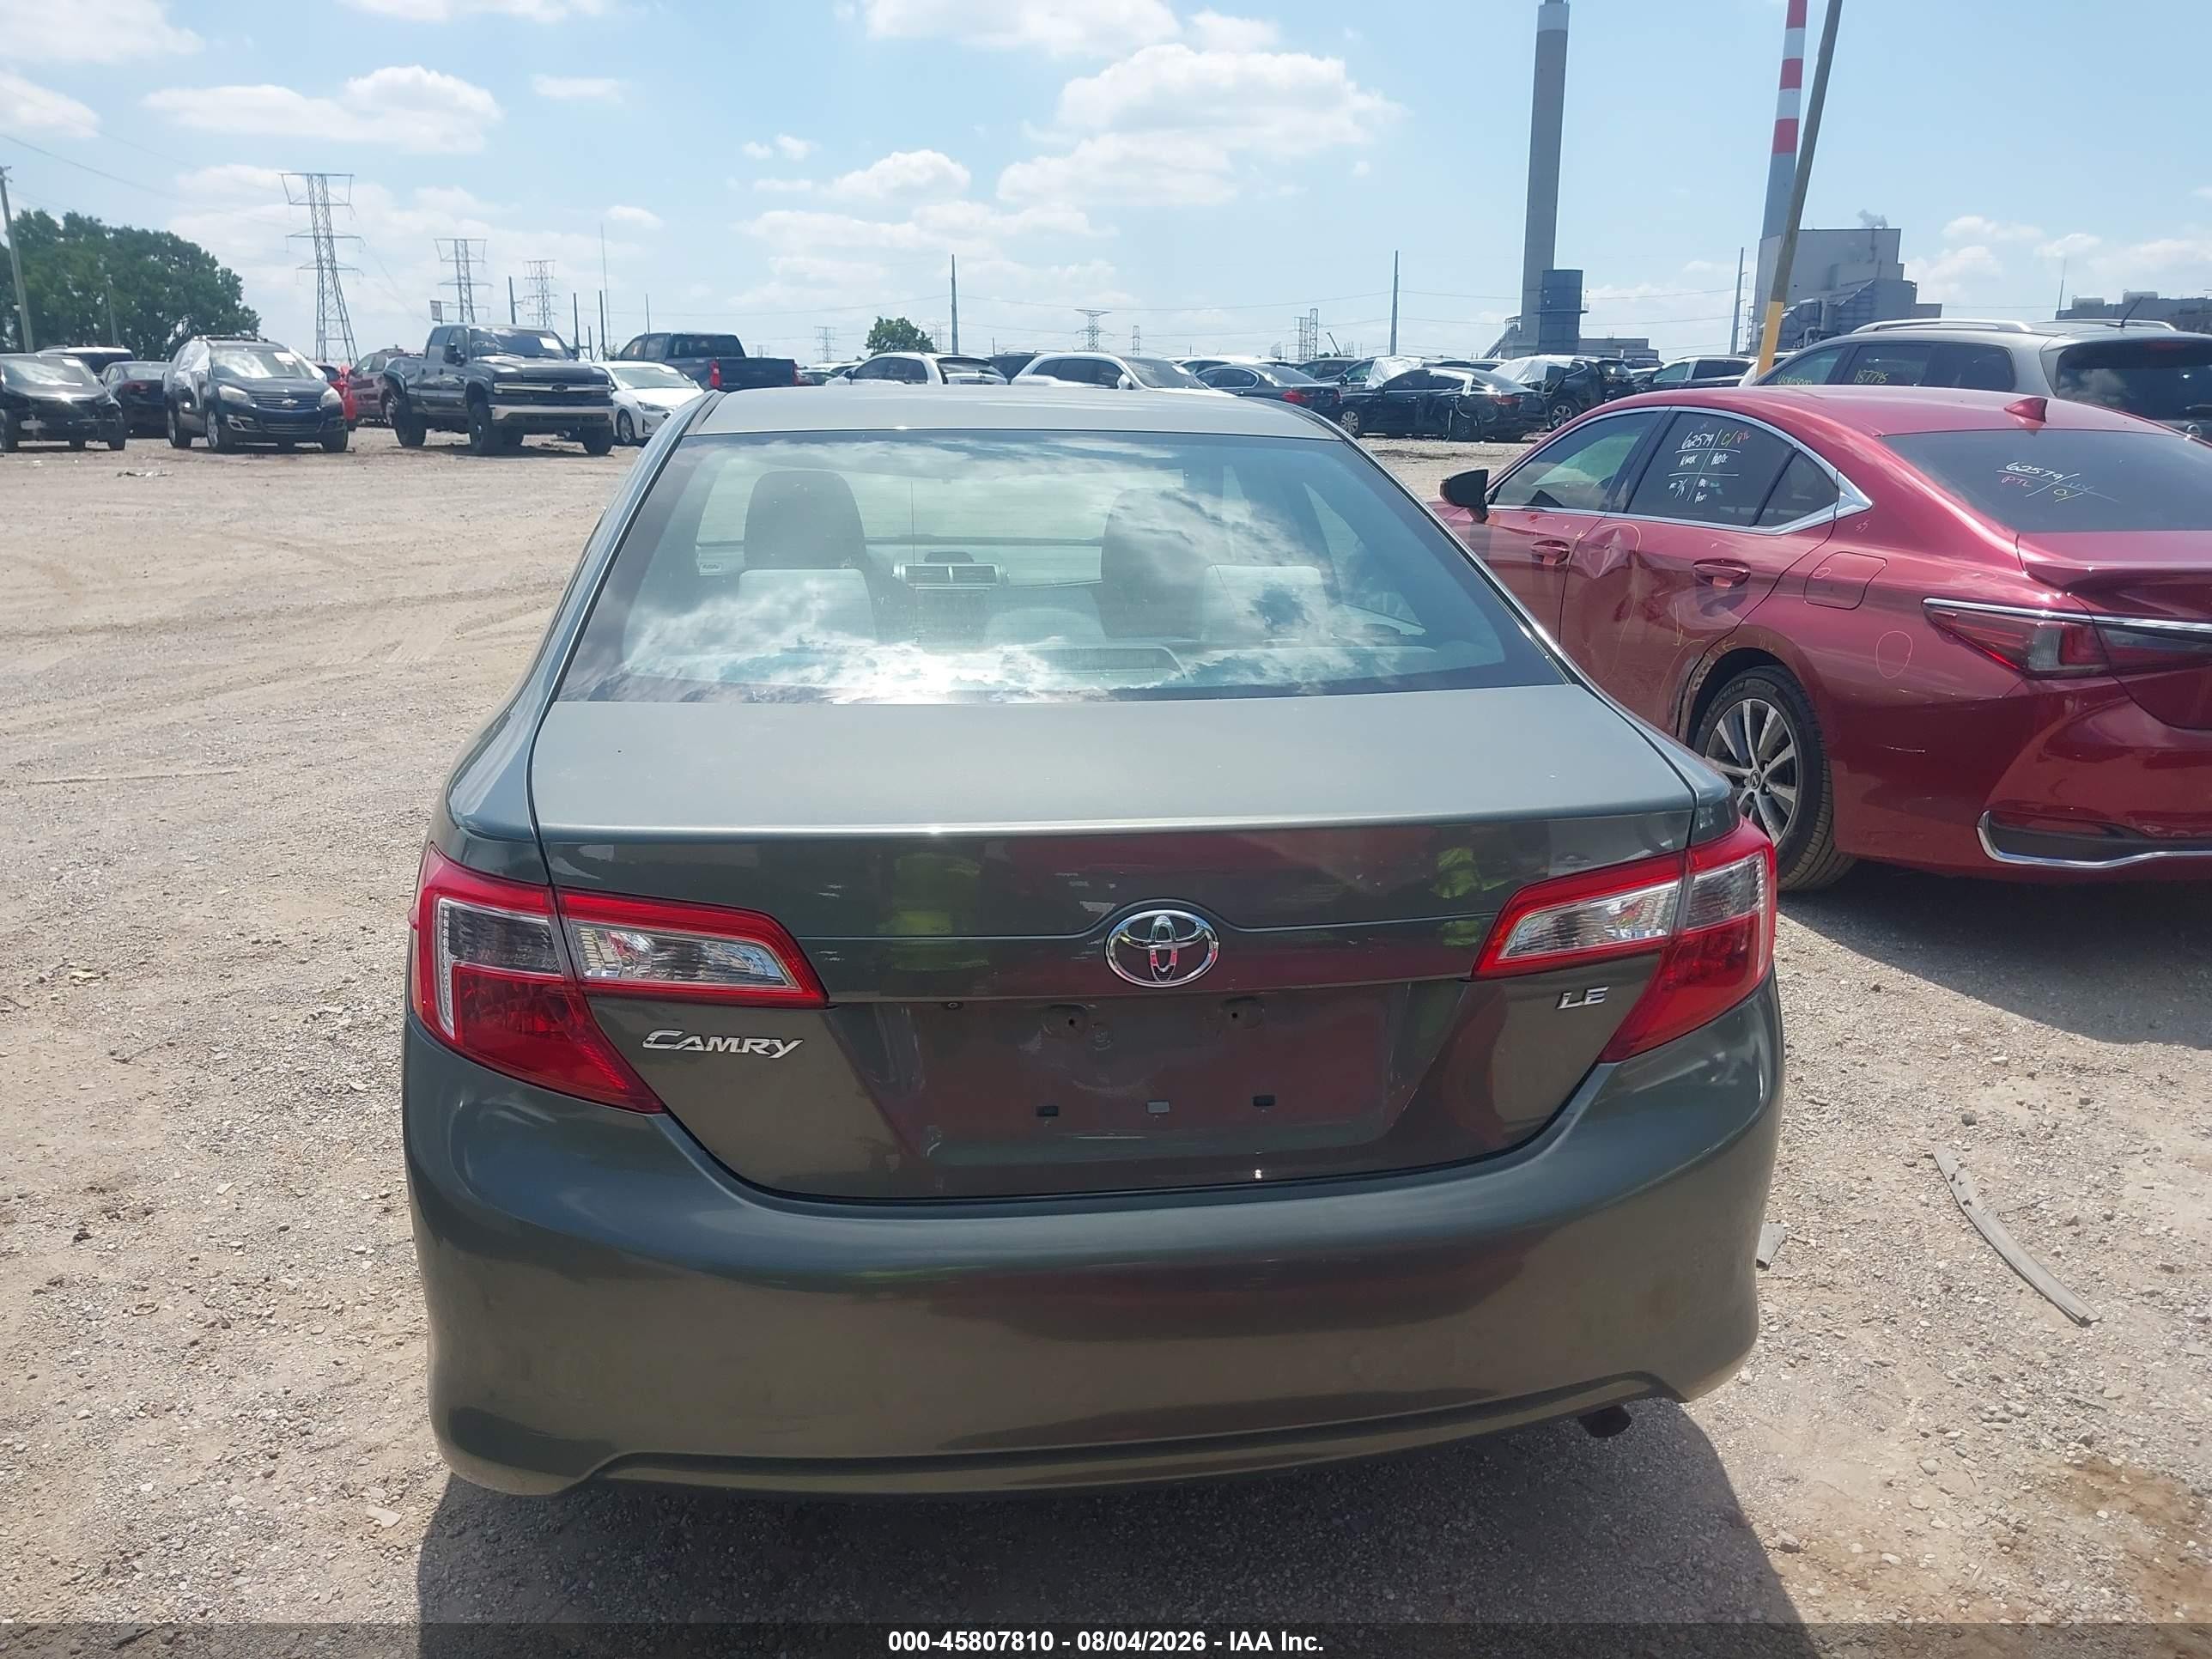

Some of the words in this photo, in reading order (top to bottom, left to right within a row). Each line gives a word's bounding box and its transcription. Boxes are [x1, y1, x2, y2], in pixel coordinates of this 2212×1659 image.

[2005, 461, 2063, 480] 62579
[1556, 986, 1610, 1010] LE
[642, 1030, 804, 1059] CAMRY
